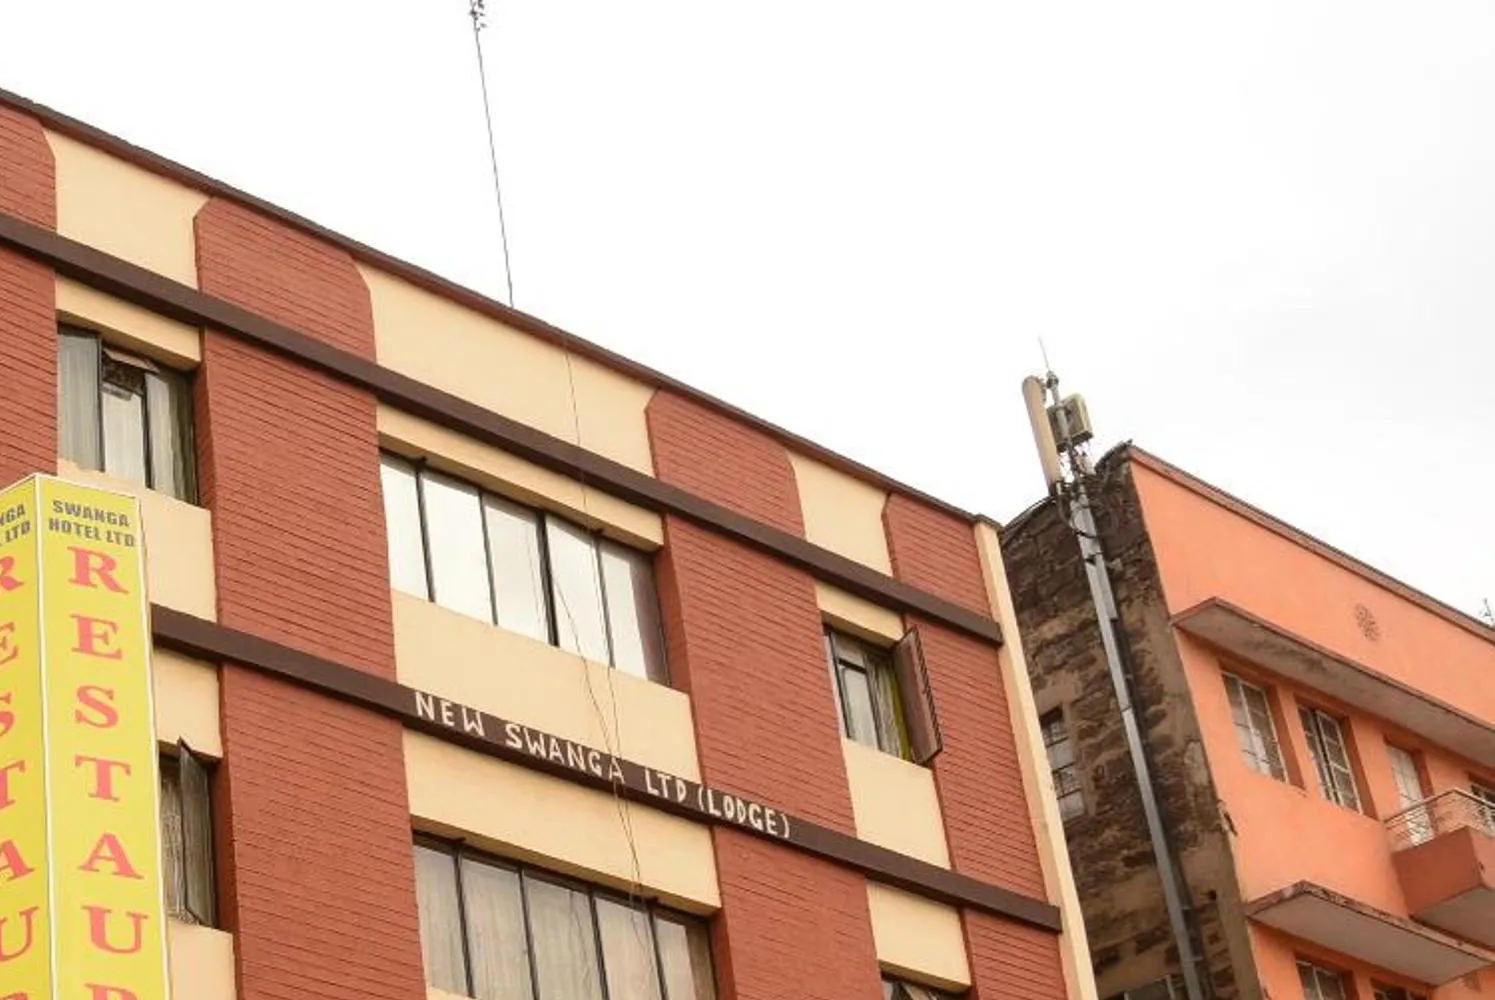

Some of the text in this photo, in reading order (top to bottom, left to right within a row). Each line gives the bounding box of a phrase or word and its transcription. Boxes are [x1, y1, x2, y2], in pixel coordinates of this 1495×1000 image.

[53, 499, 130, 527] SWANGA
[6, 520, 32, 542] LTD
[49, 518, 135, 548] HOTEL LTD
[415, 691, 791, 839] NEW SWANGA LTD (LODGE)
